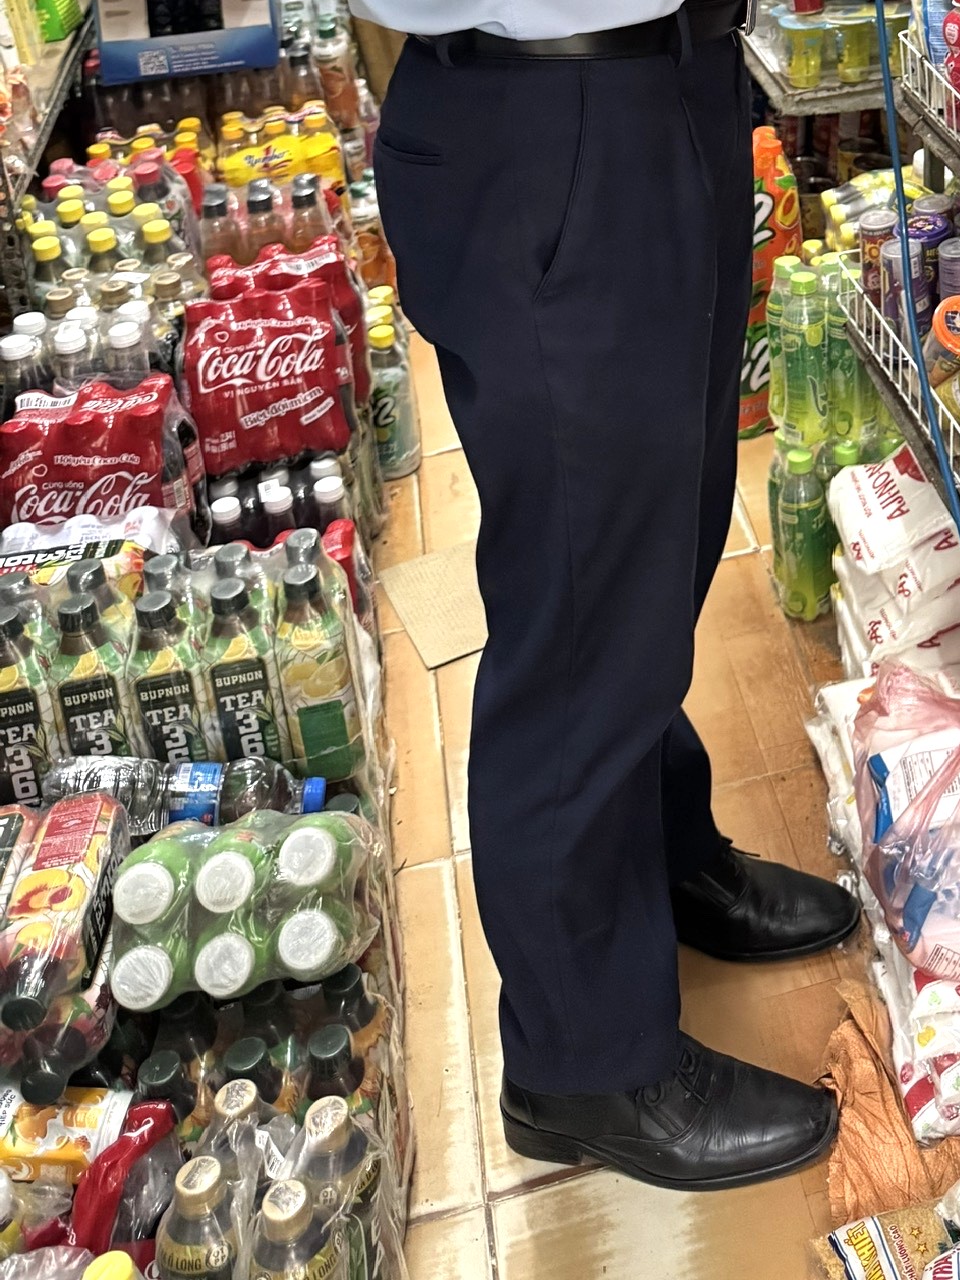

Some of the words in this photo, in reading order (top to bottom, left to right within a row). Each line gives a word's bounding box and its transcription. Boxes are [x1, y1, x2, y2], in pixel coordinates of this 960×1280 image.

[196, 329, 331, 395] Coca-Cola
[11, 471, 159, 524] Coca-Cola
[866, 462, 911, 521] AJI-NO-M
[214, 668, 264, 689] BUPNON
[63, 686, 115, 707] BUPNON
[139, 683, 191, 702] BUPNON
[220, 689, 266, 713] TEA
[0, 701, 36, 716] PNON
[69, 708, 118, 732] TEA
[145, 702, 193, 726] TEA
[175, 1257, 202, 1272] LONG
